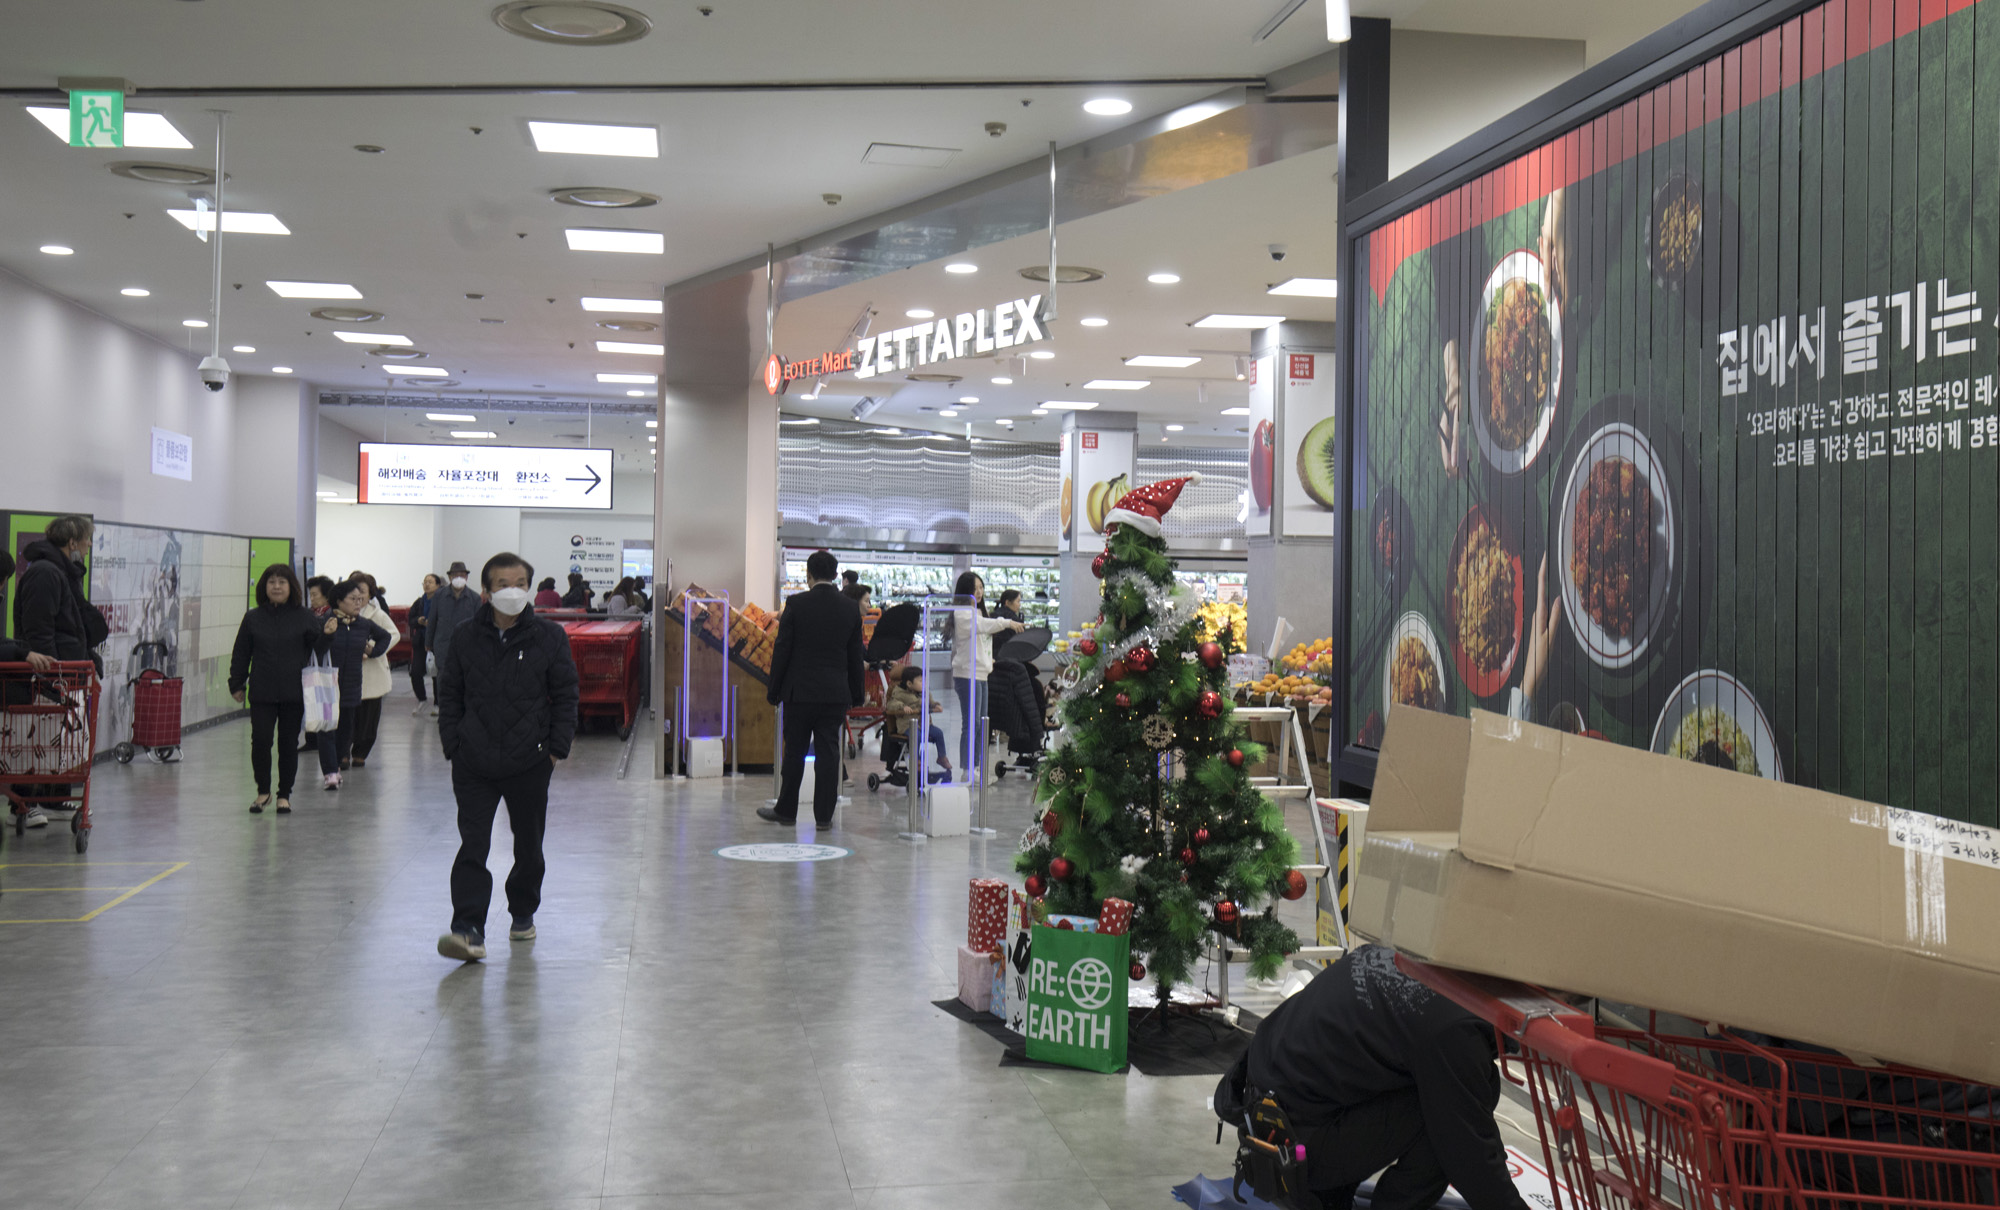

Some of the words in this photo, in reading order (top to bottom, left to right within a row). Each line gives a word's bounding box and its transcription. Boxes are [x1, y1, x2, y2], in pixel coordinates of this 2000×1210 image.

[783, 357, 819, 380] LOTTE
[820, 347, 852, 374] Mart
[855, 294, 1043, 379] ZETTAPLEX
[1716, 306, 1826, 397] 집에서
[1839, 278, 1982, 375] 즐기는
[1830, 393, 1893, 426] 건강하고
[1897, 378, 1969, 418] 전문적인
[1975, 374, 2000, 406] 레
[1773, 438, 1817, 466] 요리를
[1820, 435, 1850, 463] 가장
[1854, 431, 1886, 460] 쉽고
[1891, 419, 1961, 456] 간편하게
[378, 468, 427, 481] 해외배송
[438, 469, 499, 482] 자율포장대
[516, 471, 551, 484] 환전소
[1031, 957, 1065, 998] RE:
[1028, 1003, 1111, 1050] EARTH
